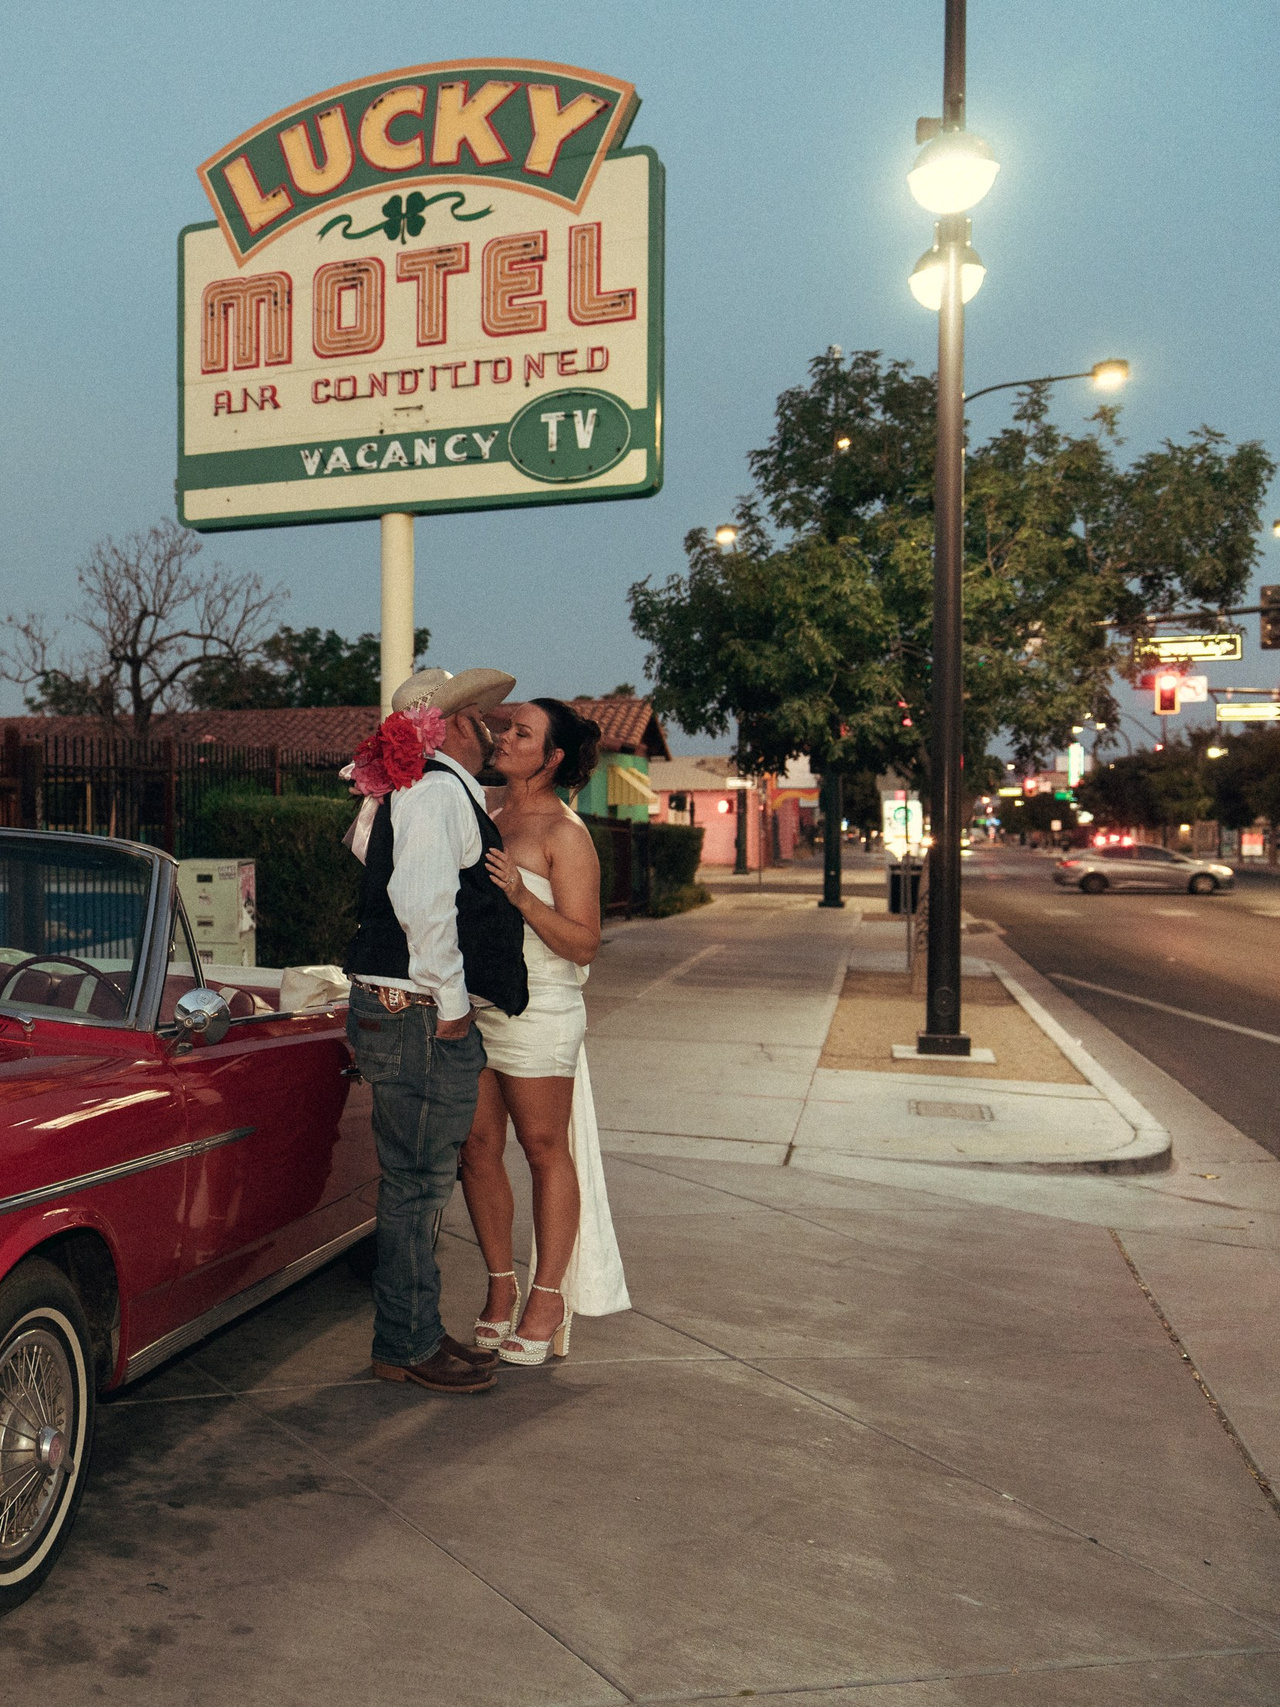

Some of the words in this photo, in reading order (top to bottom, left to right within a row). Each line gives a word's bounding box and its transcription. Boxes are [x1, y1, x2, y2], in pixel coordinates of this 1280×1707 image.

[222, 80, 612, 236] LUCKY
[201, 222, 637, 375] MOTEL
[214, 384, 281, 415] AIR
[310, 345, 610, 404] CONDITIONED
[300, 430, 500, 476] VACANCY
[540, 408, 598, 452] TV
